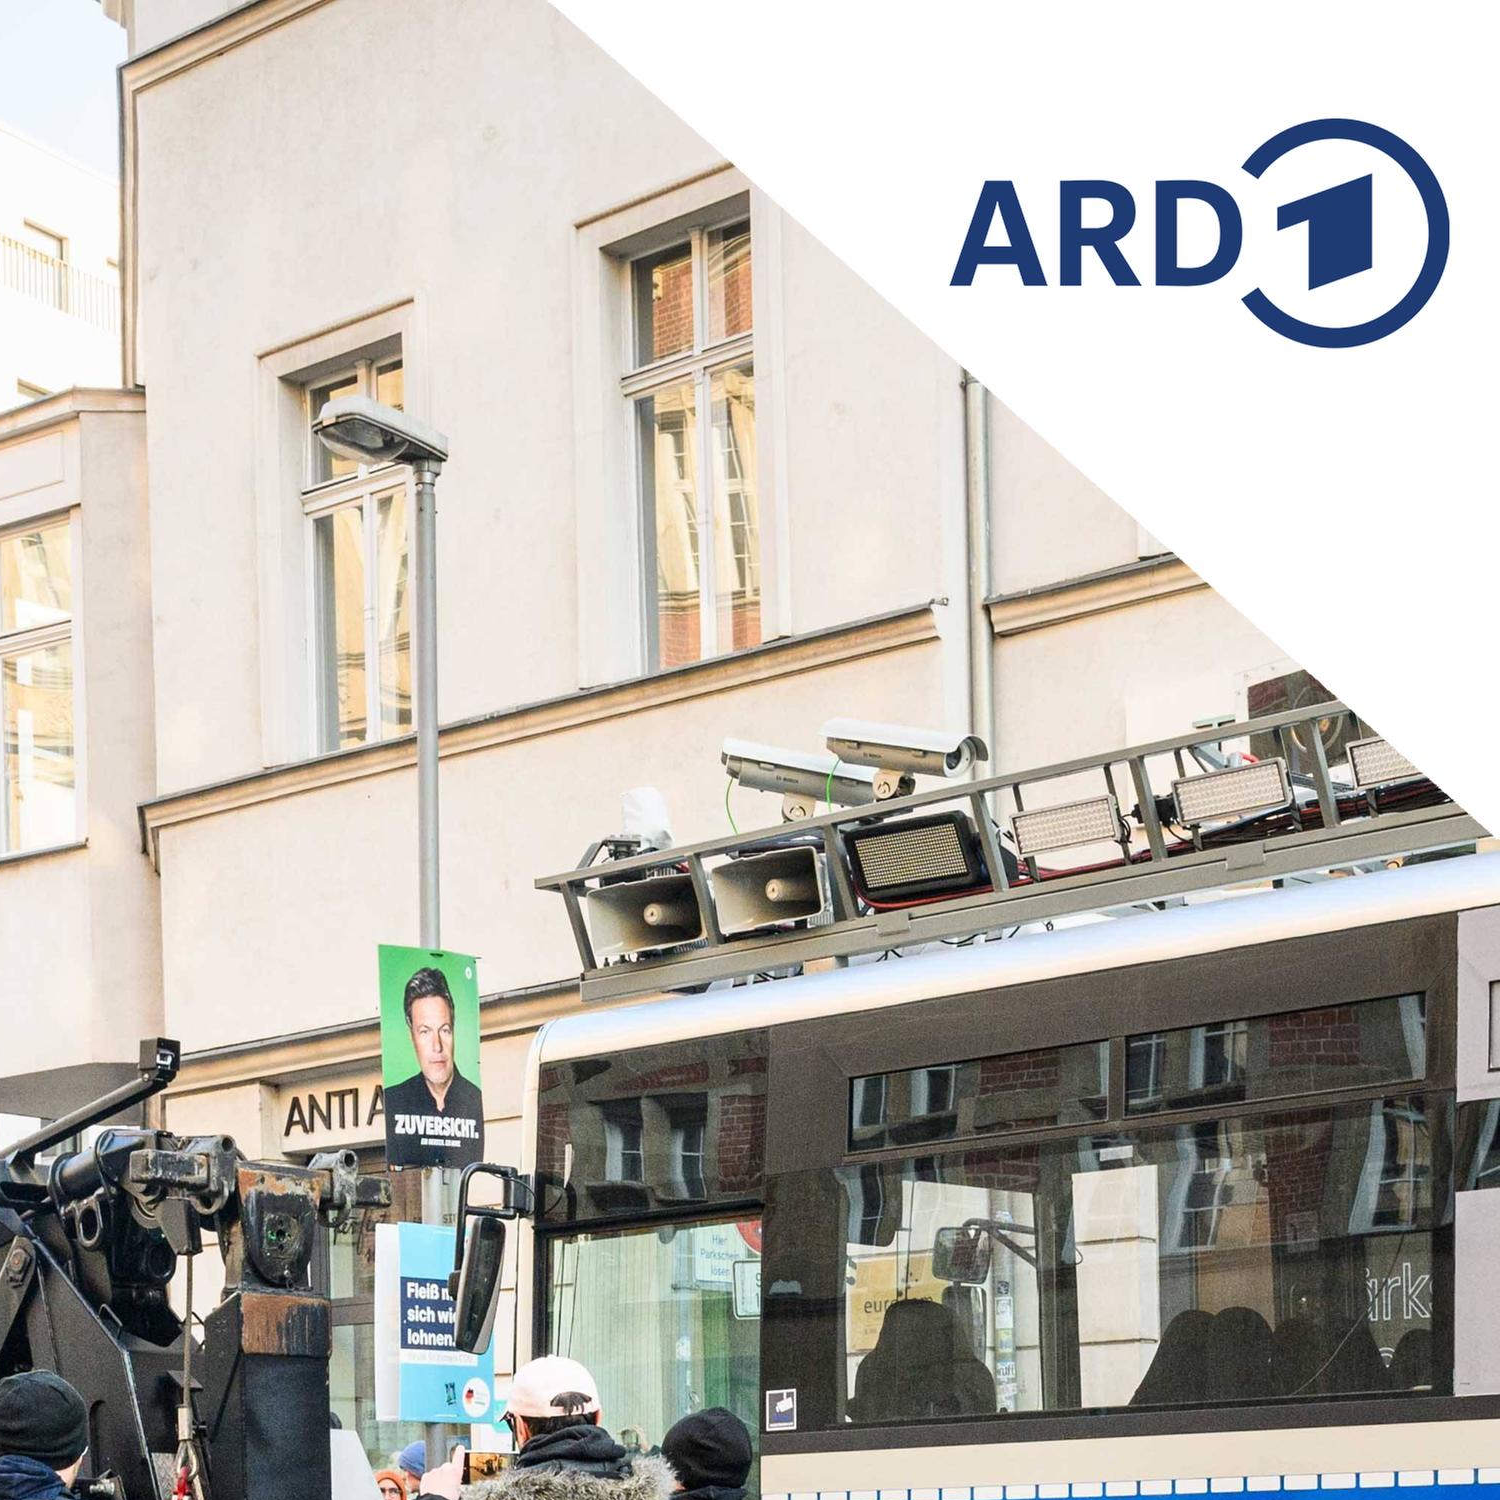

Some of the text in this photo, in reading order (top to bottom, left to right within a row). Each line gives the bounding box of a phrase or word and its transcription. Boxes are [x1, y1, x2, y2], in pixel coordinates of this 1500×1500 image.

[283, 1087, 359, 1137] ANTI
[394, 1114, 480, 1139] ZUVERSICHT.
[406, 1281, 440, 1301] Fleiß
[406, 1305, 436, 1323] sich
